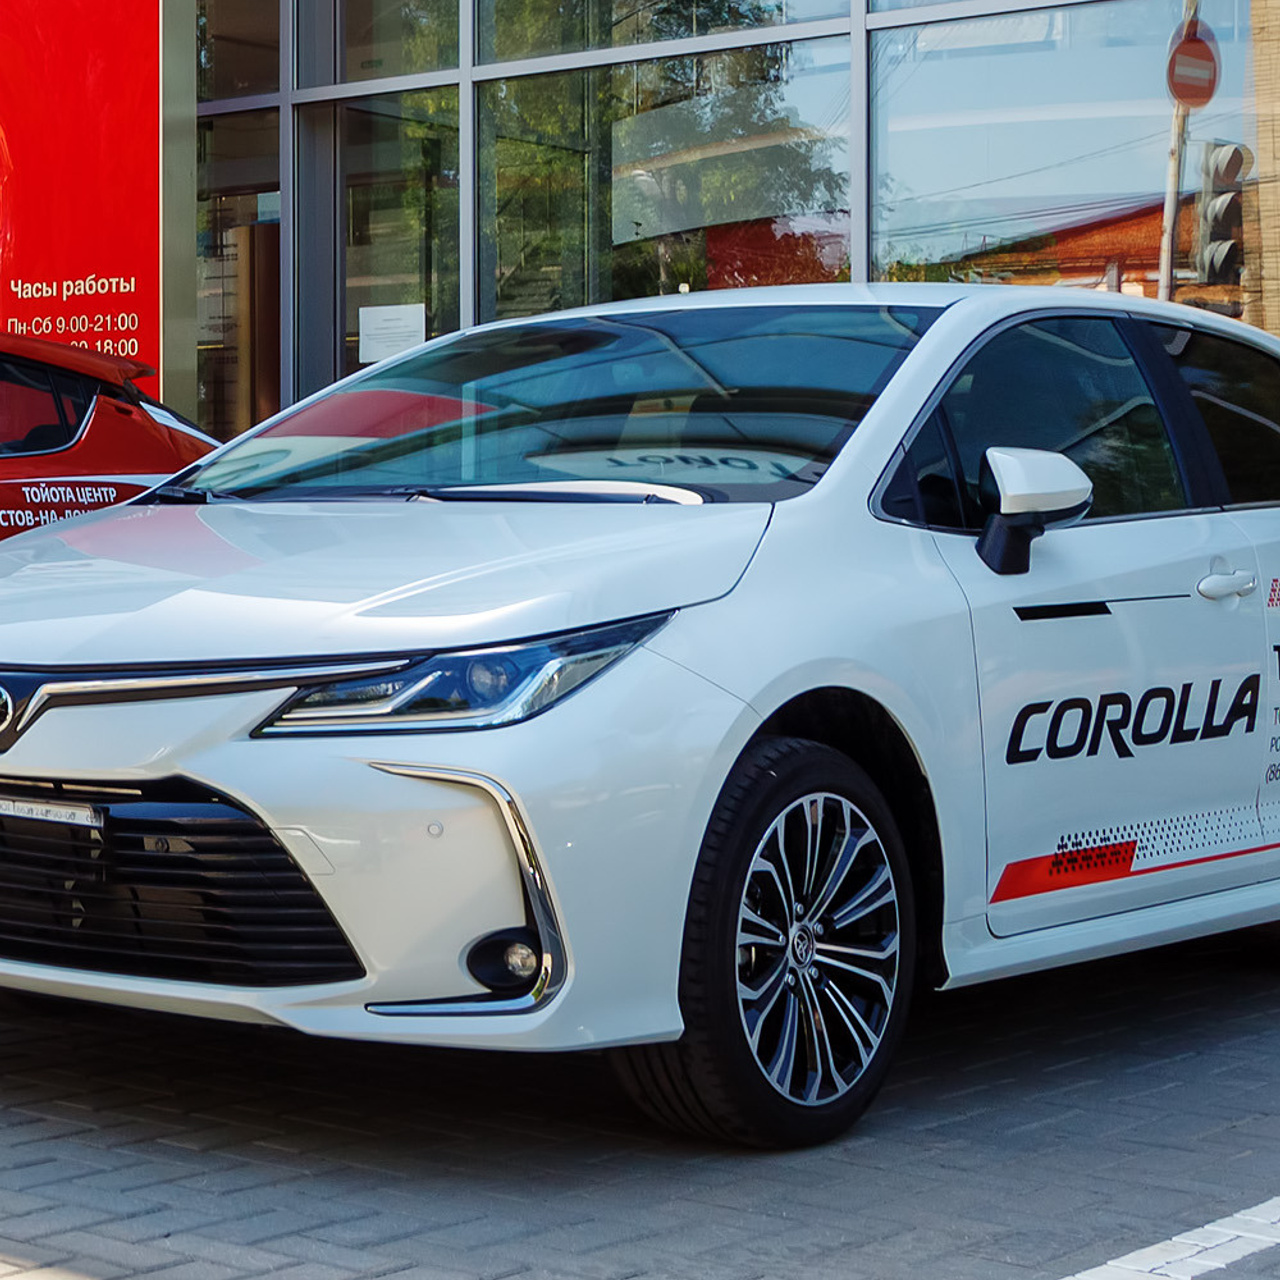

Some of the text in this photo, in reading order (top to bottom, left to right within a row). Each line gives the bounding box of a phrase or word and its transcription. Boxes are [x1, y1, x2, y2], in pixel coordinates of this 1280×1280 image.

[10, 274, 136, 301] Часы работы
[21, 483, 117, 504] ТОЙОТА ЦЕНТР
[1005, 673, 1261, 765] COROLLA
